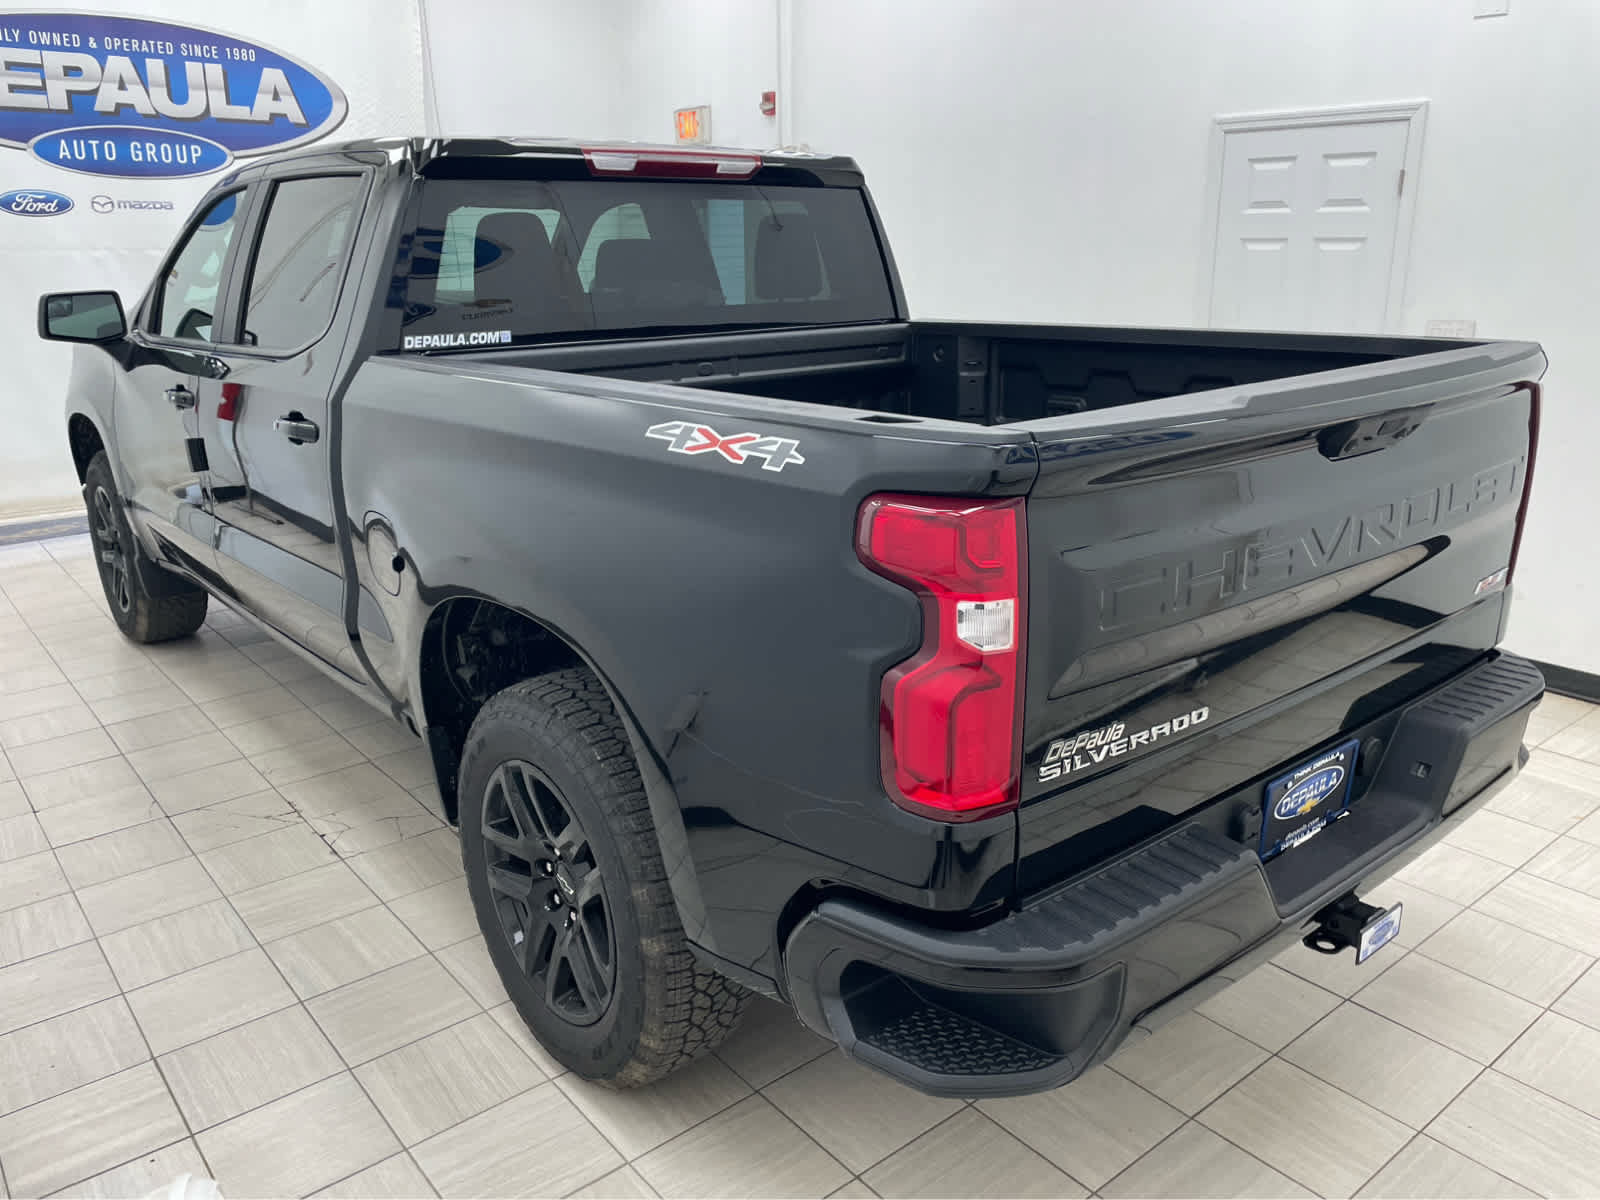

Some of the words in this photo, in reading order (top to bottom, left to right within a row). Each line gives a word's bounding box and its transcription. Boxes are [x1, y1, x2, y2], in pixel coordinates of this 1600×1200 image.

[29, 30, 81, 48] OWNED
[88, 36, 98, 49] &
[104, 37, 174, 56] OPERATED
[180, 44, 219, 59] SINCE
[225, 47, 257, 62] 1980
[58, 139, 117, 162] AUTO
[130, 141, 202, 165] GROUP
[11, 193, 59, 214] Ford
[117, 199, 174, 210] mazda
[404, 330, 500, 349] DEPAULA.COM
[1099, 455, 1525, 632] CHEVROLET
[1038, 706, 1209, 782] SILVERADO
[1280, 771, 1338, 816] DEPAULA
